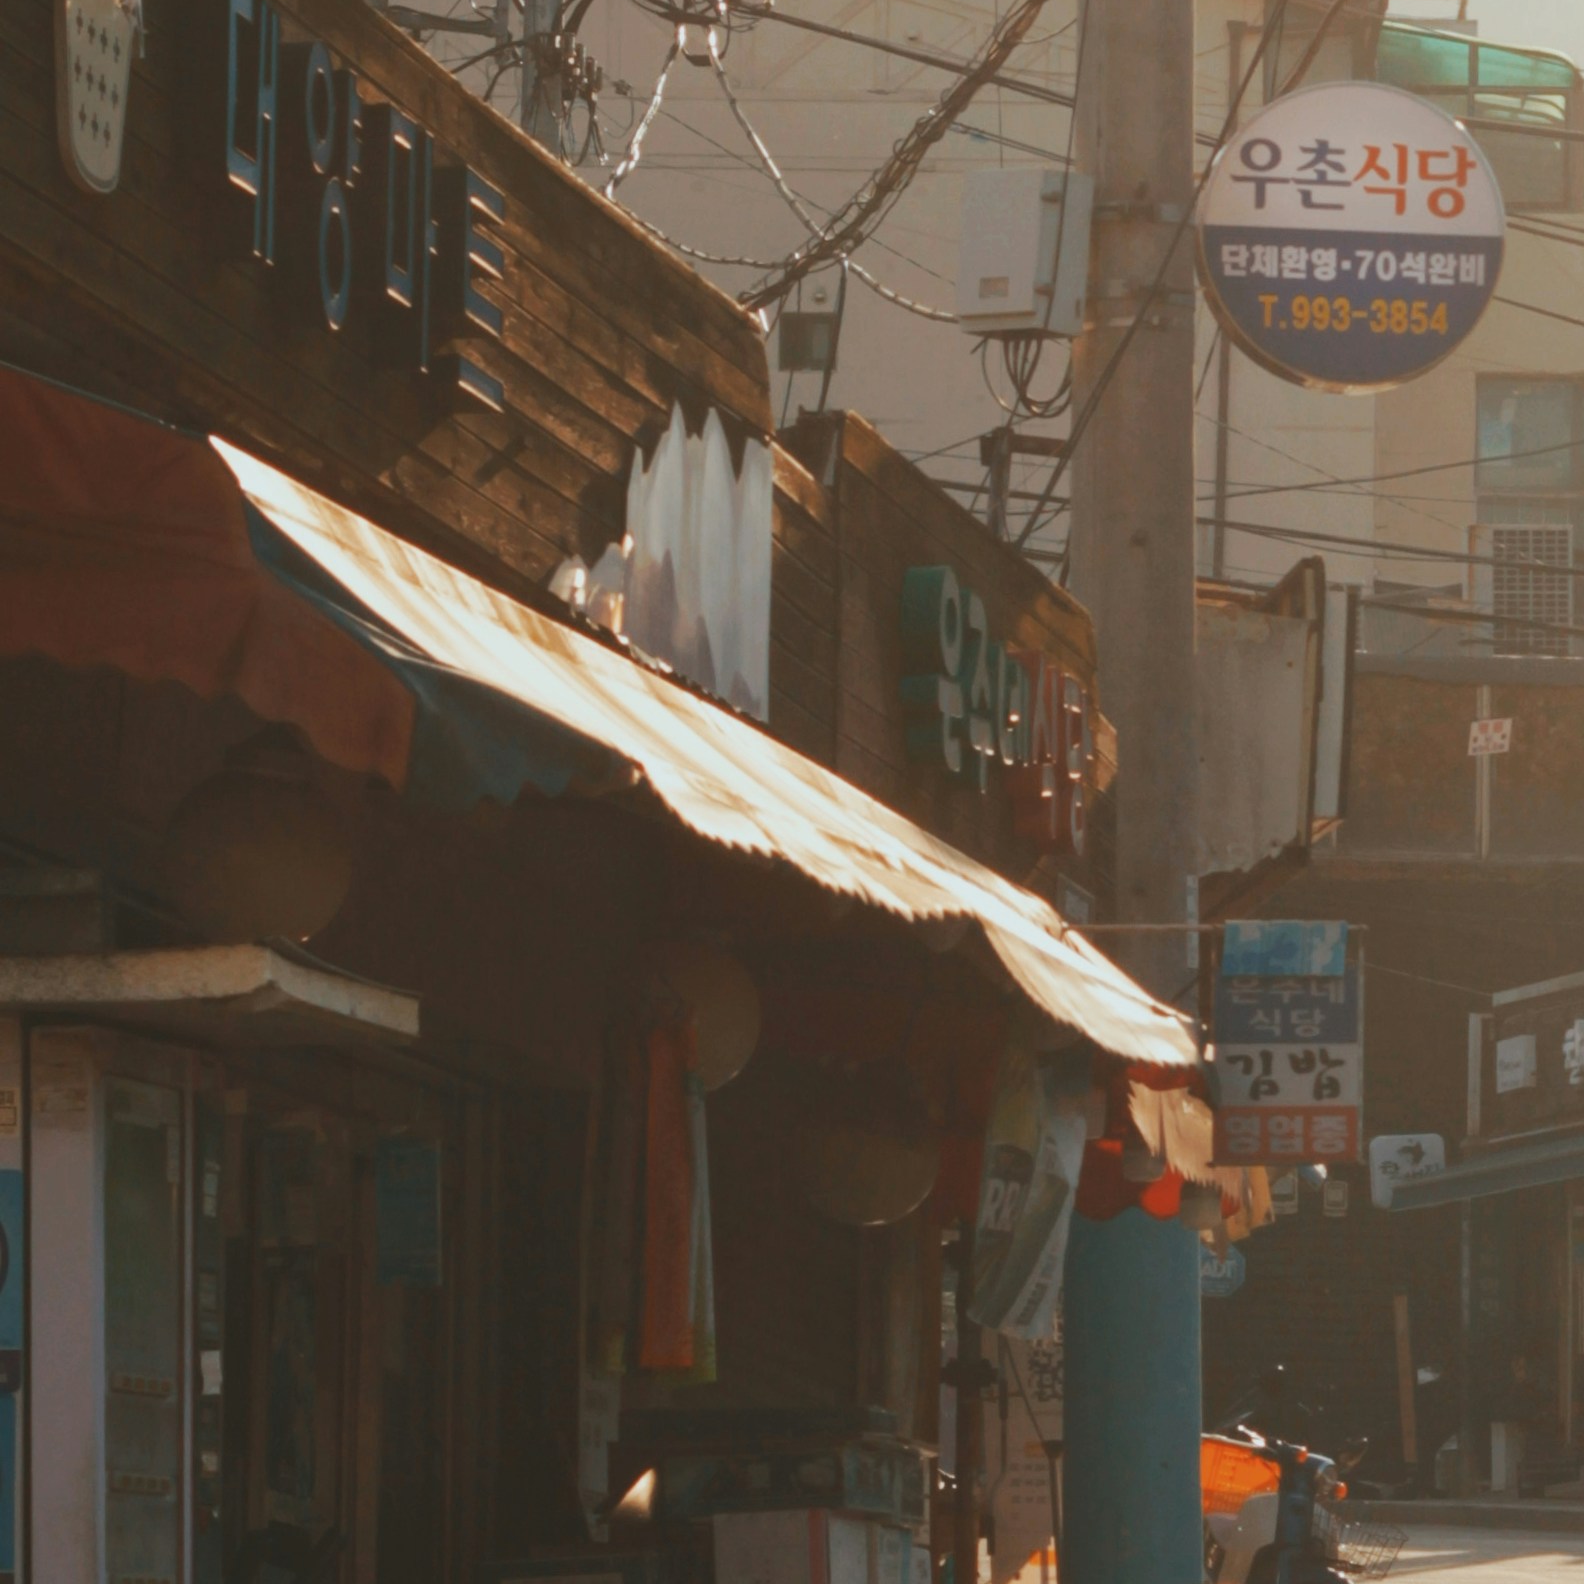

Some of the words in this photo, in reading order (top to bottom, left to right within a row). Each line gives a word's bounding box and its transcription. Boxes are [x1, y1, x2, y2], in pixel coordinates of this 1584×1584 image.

[1230, 138, 1477, 219] 우촌식당
[1258, 294, 1448, 335] T.993-3854
[1249, 1008, 1327, 1038] 식당
[1225, 1048, 1346, 1101] 김밥
[1224, 1115, 1348, 1154] 영업중
